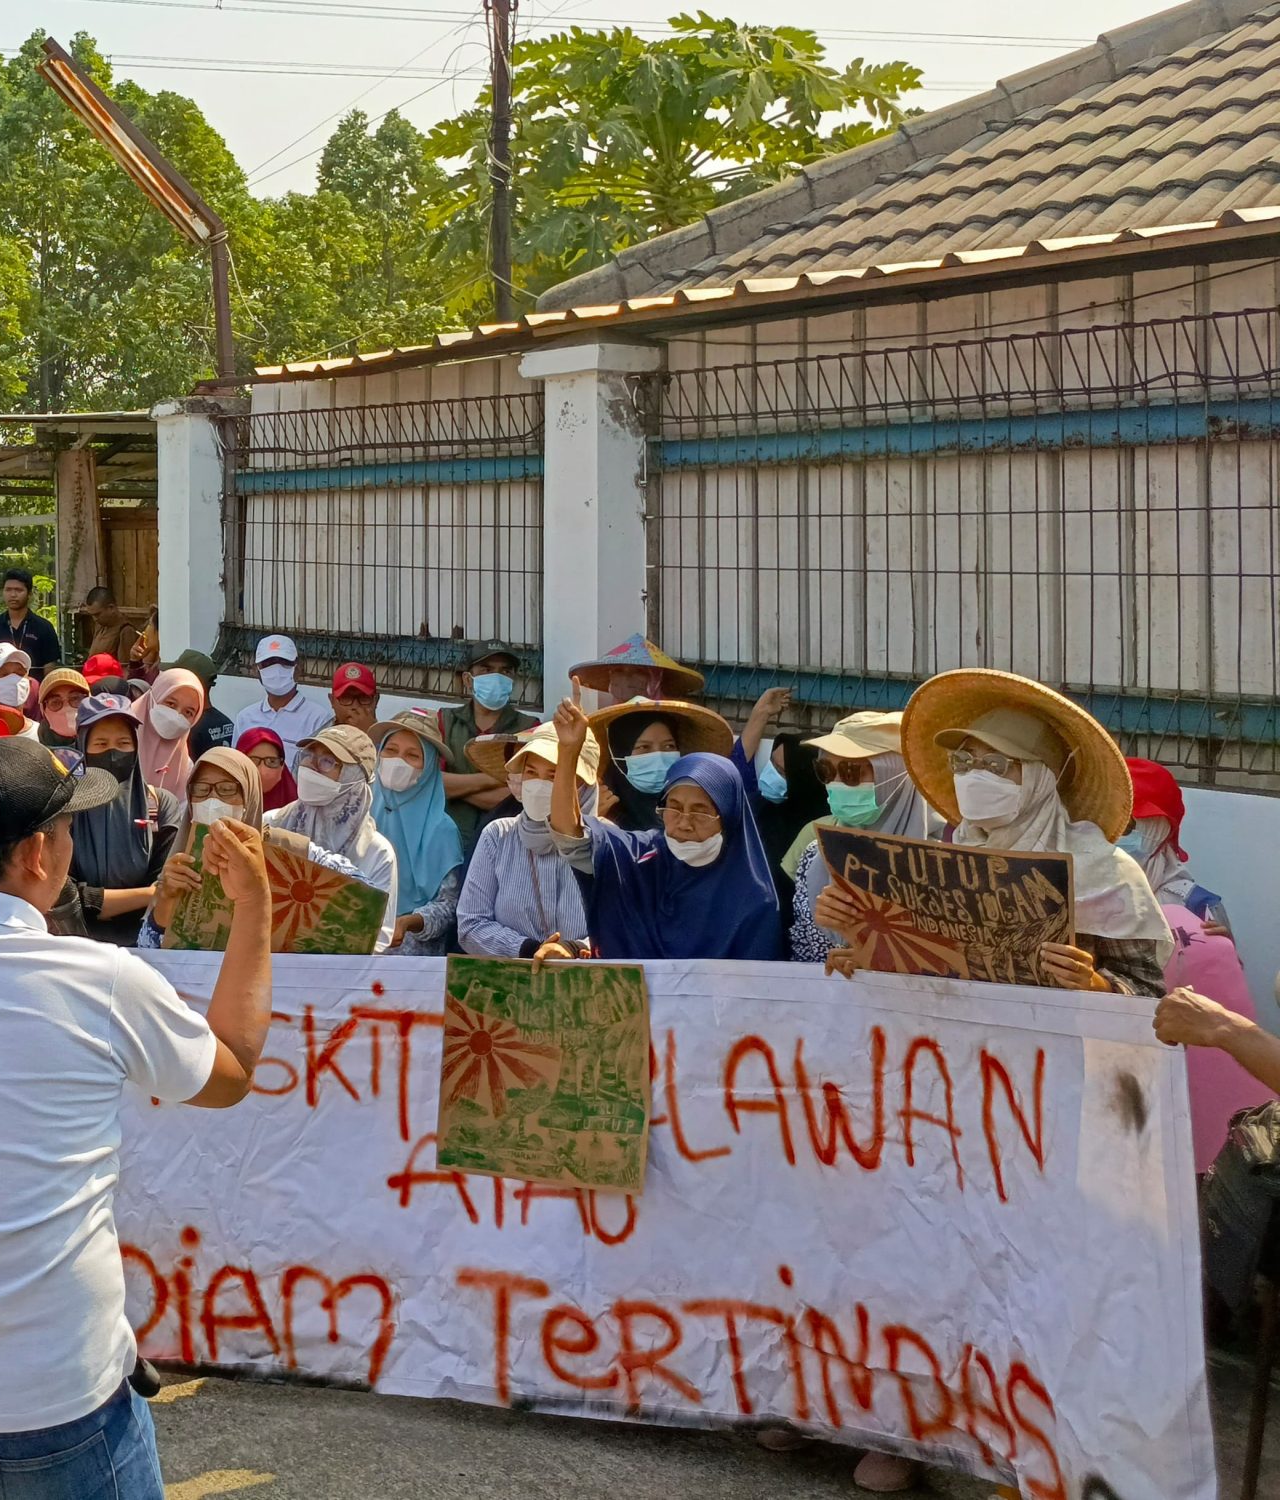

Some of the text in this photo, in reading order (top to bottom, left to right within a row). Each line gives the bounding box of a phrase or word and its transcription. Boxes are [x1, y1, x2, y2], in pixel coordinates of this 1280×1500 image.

[875, 840, 1009, 892] TUTUP
[886, 875, 973, 922] SUKSES
[975, 866, 1065, 926] LOGAM
[911, 913, 997, 945] INDONESIA
